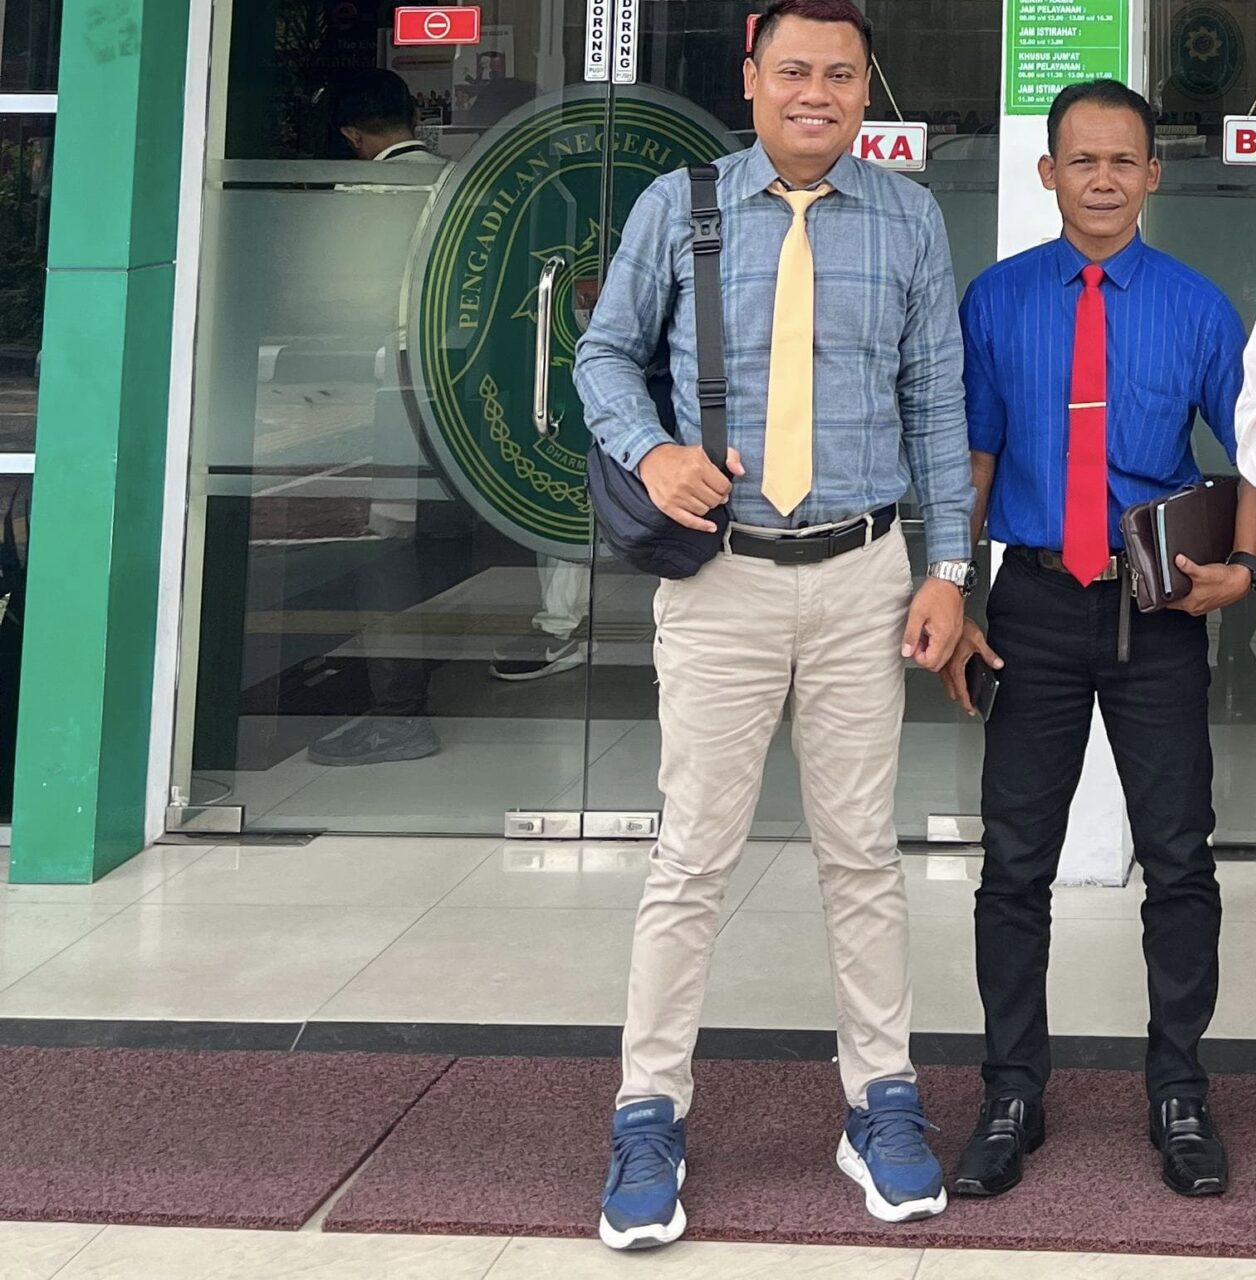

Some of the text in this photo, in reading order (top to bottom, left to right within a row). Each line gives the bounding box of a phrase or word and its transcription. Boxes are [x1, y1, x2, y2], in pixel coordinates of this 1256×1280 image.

[1019, 6, 1035, 14] JAM
[1037, 6, 1082, 14] PELAYANAN
[1019, 27, 1036, 36] JAM
[1037, 27, 1077, 36] ISTIRAHAT
[1018, 52, 1080, 61] KHUSUS JUM'AT
[1018, 63, 1035, 71] JAM
[1036, 63, 1081, 71] PELAYANAN
[1018, 85, 1035, 94] JAM
[851, 134, 914, 160] KA
[458, 131, 674, 330] PENGADILAN NEGERI
